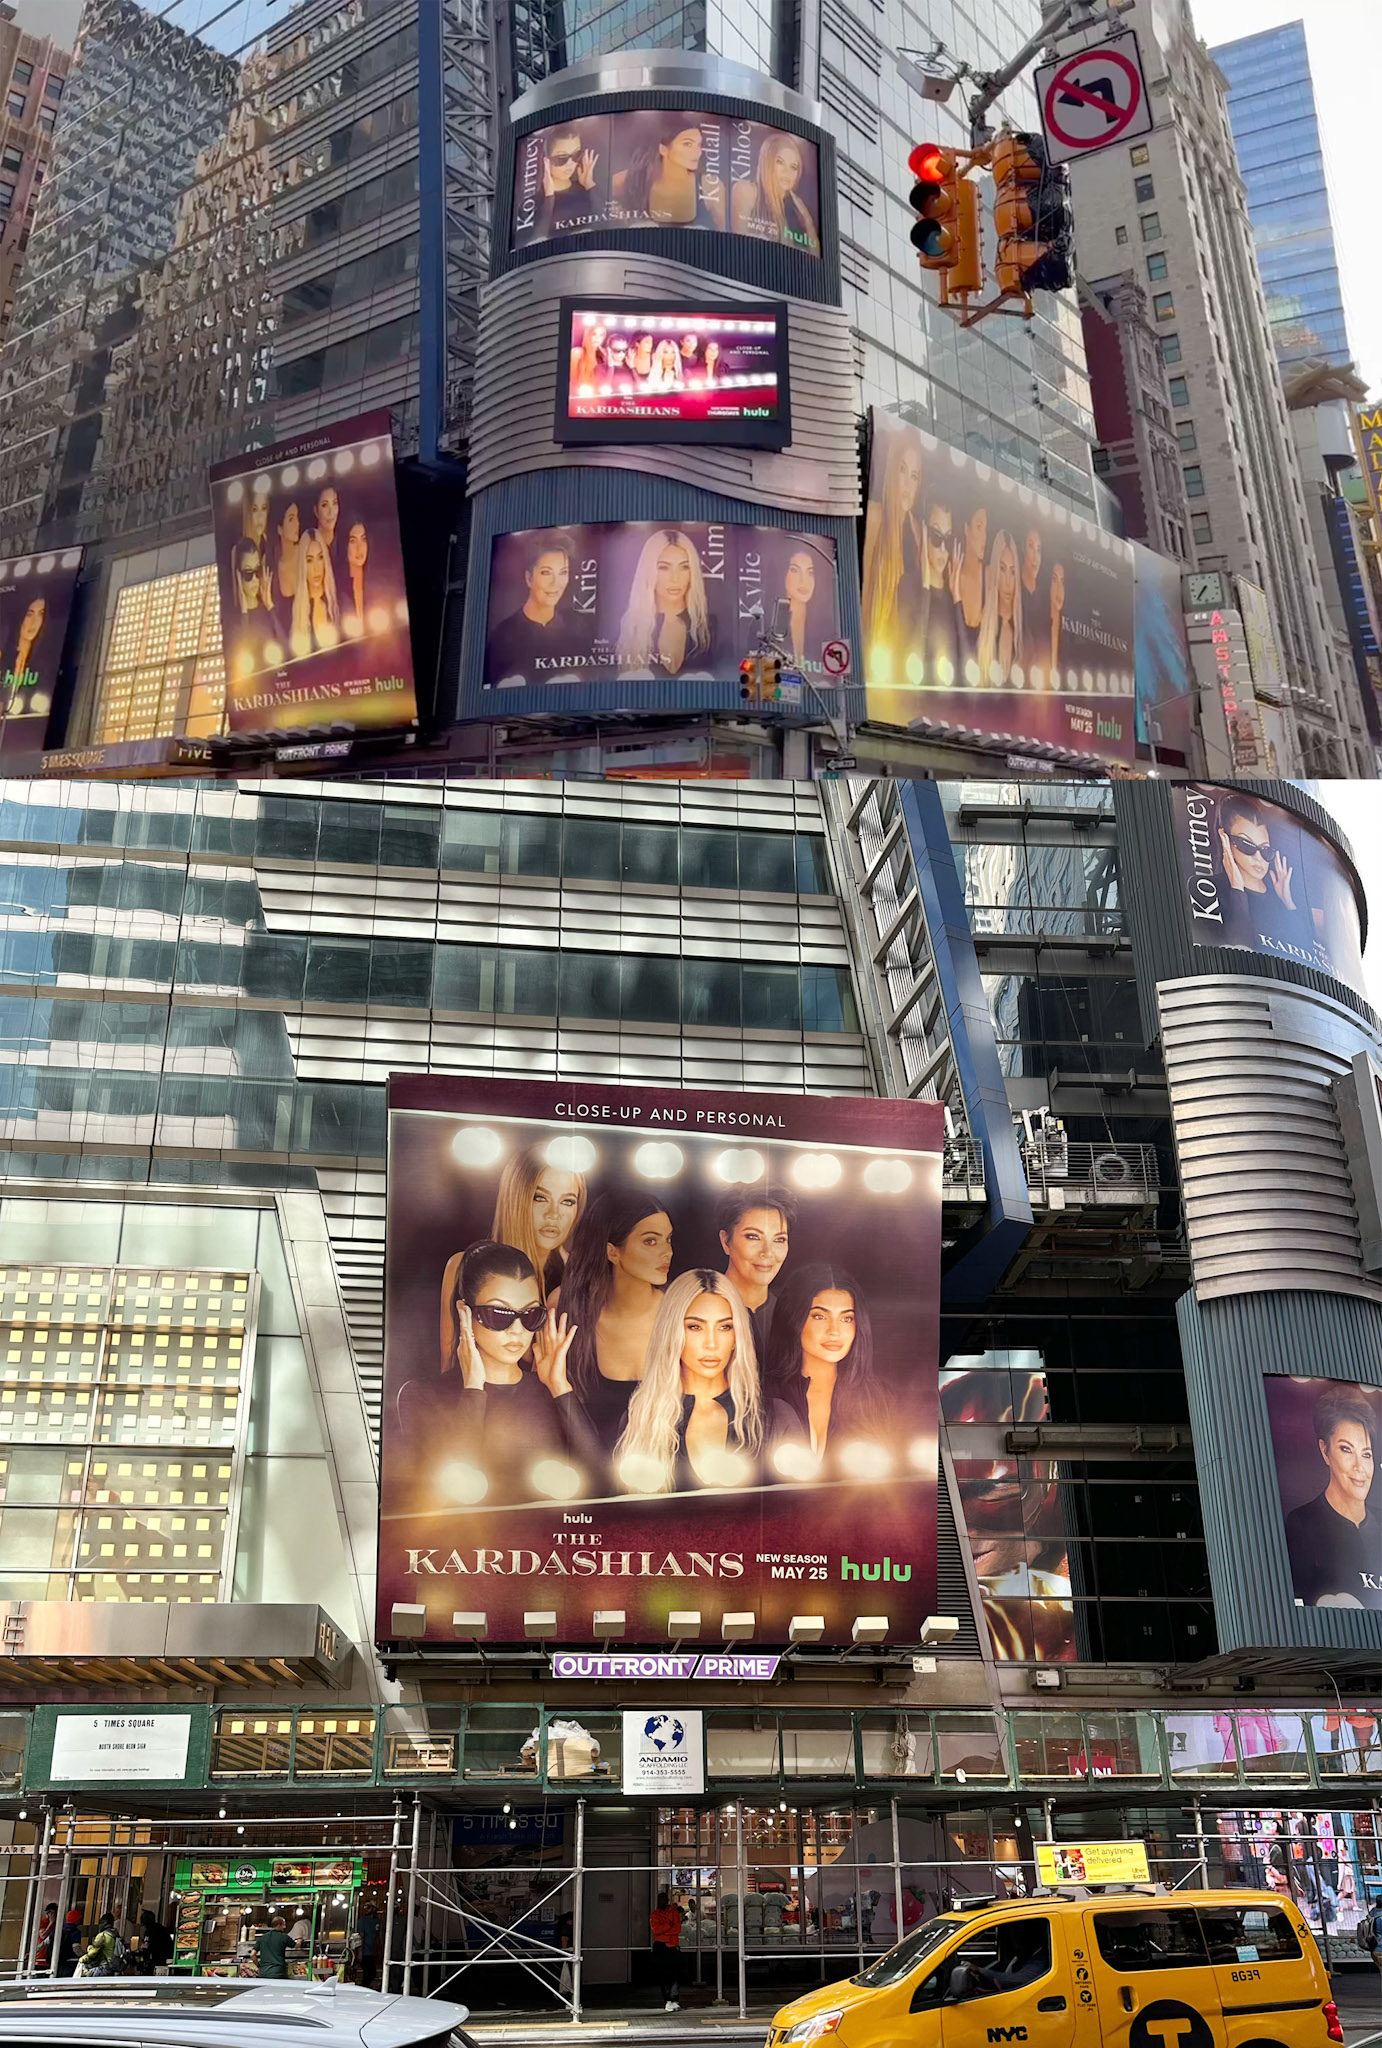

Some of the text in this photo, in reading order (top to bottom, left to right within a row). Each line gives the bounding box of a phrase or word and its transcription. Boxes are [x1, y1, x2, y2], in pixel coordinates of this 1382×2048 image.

[699, 123, 721, 202] Kendall
[516, 137, 543, 231] Kourtney
[555, 210, 672, 230] KARDASHIANS
[784, 226, 817, 247] hulu
[577, 405, 680, 416] KARDASHIANS
[743, 407, 769, 417] hulu
[285, 446, 299, 457] AND
[300, 436, 332, 452] PERSONAL
[701, 525, 725, 581] Kim
[573, 559, 597, 614] Kris
[739, 552, 764, 619] Kylie
[535, 653, 672, 669] KARDASHIANS
[801, 656, 822, 672] hu
[5, 668, 39, 685] hulu
[375, 675, 404, 692] hulu
[234, 683, 341, 711] KARDASHIANS
[1070, 717, 1093, 734] MAY 25
[1097, 712, 1122, 740] hulu
[278, 743, 349, 760] OUTFRONT PRIME
[1186, 786, 1223, 924] Kourtney
[555, 1103, 786, 1128] CLOSE-UP AND PERSONAL
[563, 1513, 593, 1524] hulu
[552, 1533, 602, 1546] THE
[404, 1548, 744, 1578] KARDASHIANS
[756, 1553, 828, 1564] NEW SEASON
[771, 1566, 828, 1580] MAY 25
[841, 1556, 912, 1582] hulu
[559, 1657, 771, 1676] OUTFRONT PRIME
[93, 1719, 155, 1728] 5 TIMES SQUARE
[463, 1815, 474, 1830] 5
[481, 1814, 529, 1829] TIMS
[1087, 1856, 1122, 1864] delivered
[1102, 1847, 1134, 1856] anything
[1231, 1969, 1261, 1982] 8G39
[987, 2026, 1028, 2043] NYC
[1146, 2018, 1192, 2048] T
